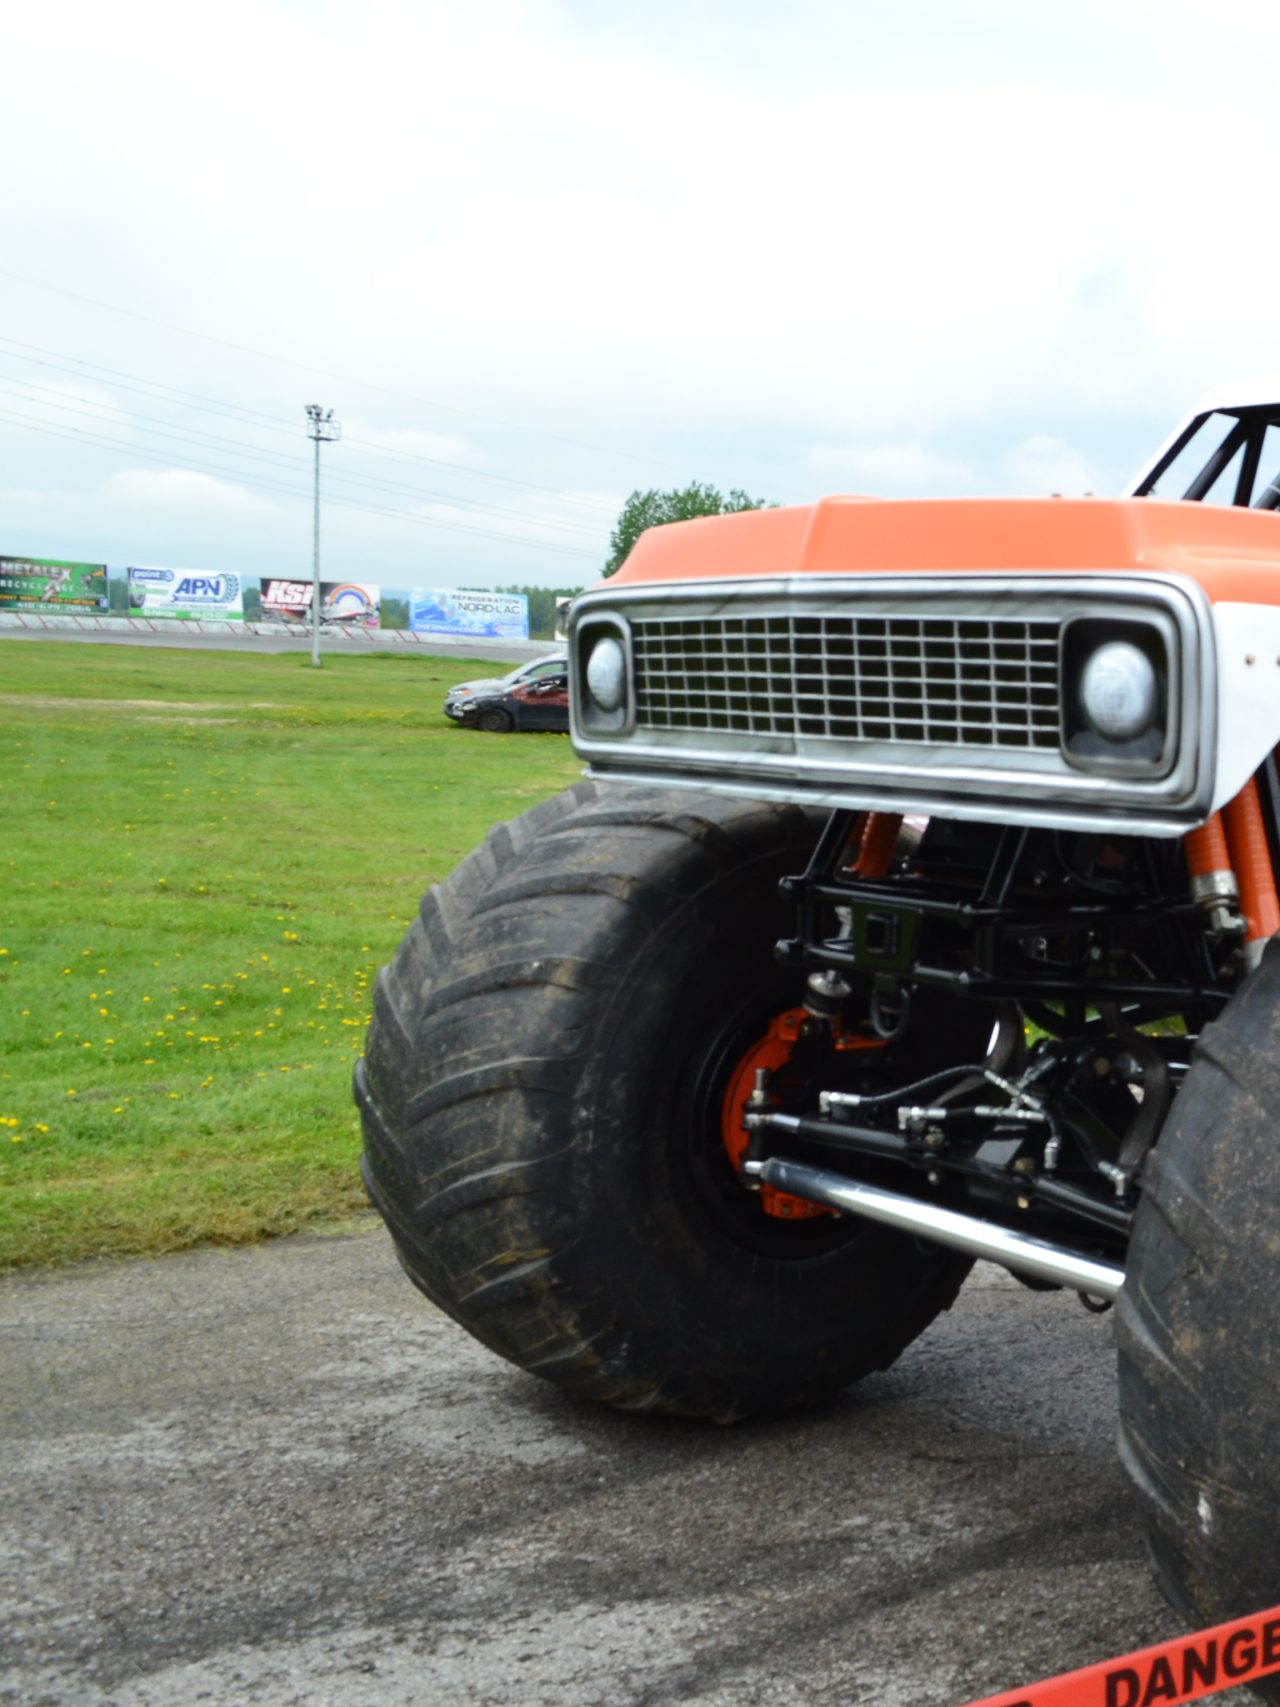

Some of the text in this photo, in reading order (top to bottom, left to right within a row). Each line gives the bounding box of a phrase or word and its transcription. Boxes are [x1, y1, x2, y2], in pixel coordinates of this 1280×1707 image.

[0, 562, 72, 582] METALEX
[133, 570, 160, 580] point
[175, 577, 221, 597] APN
